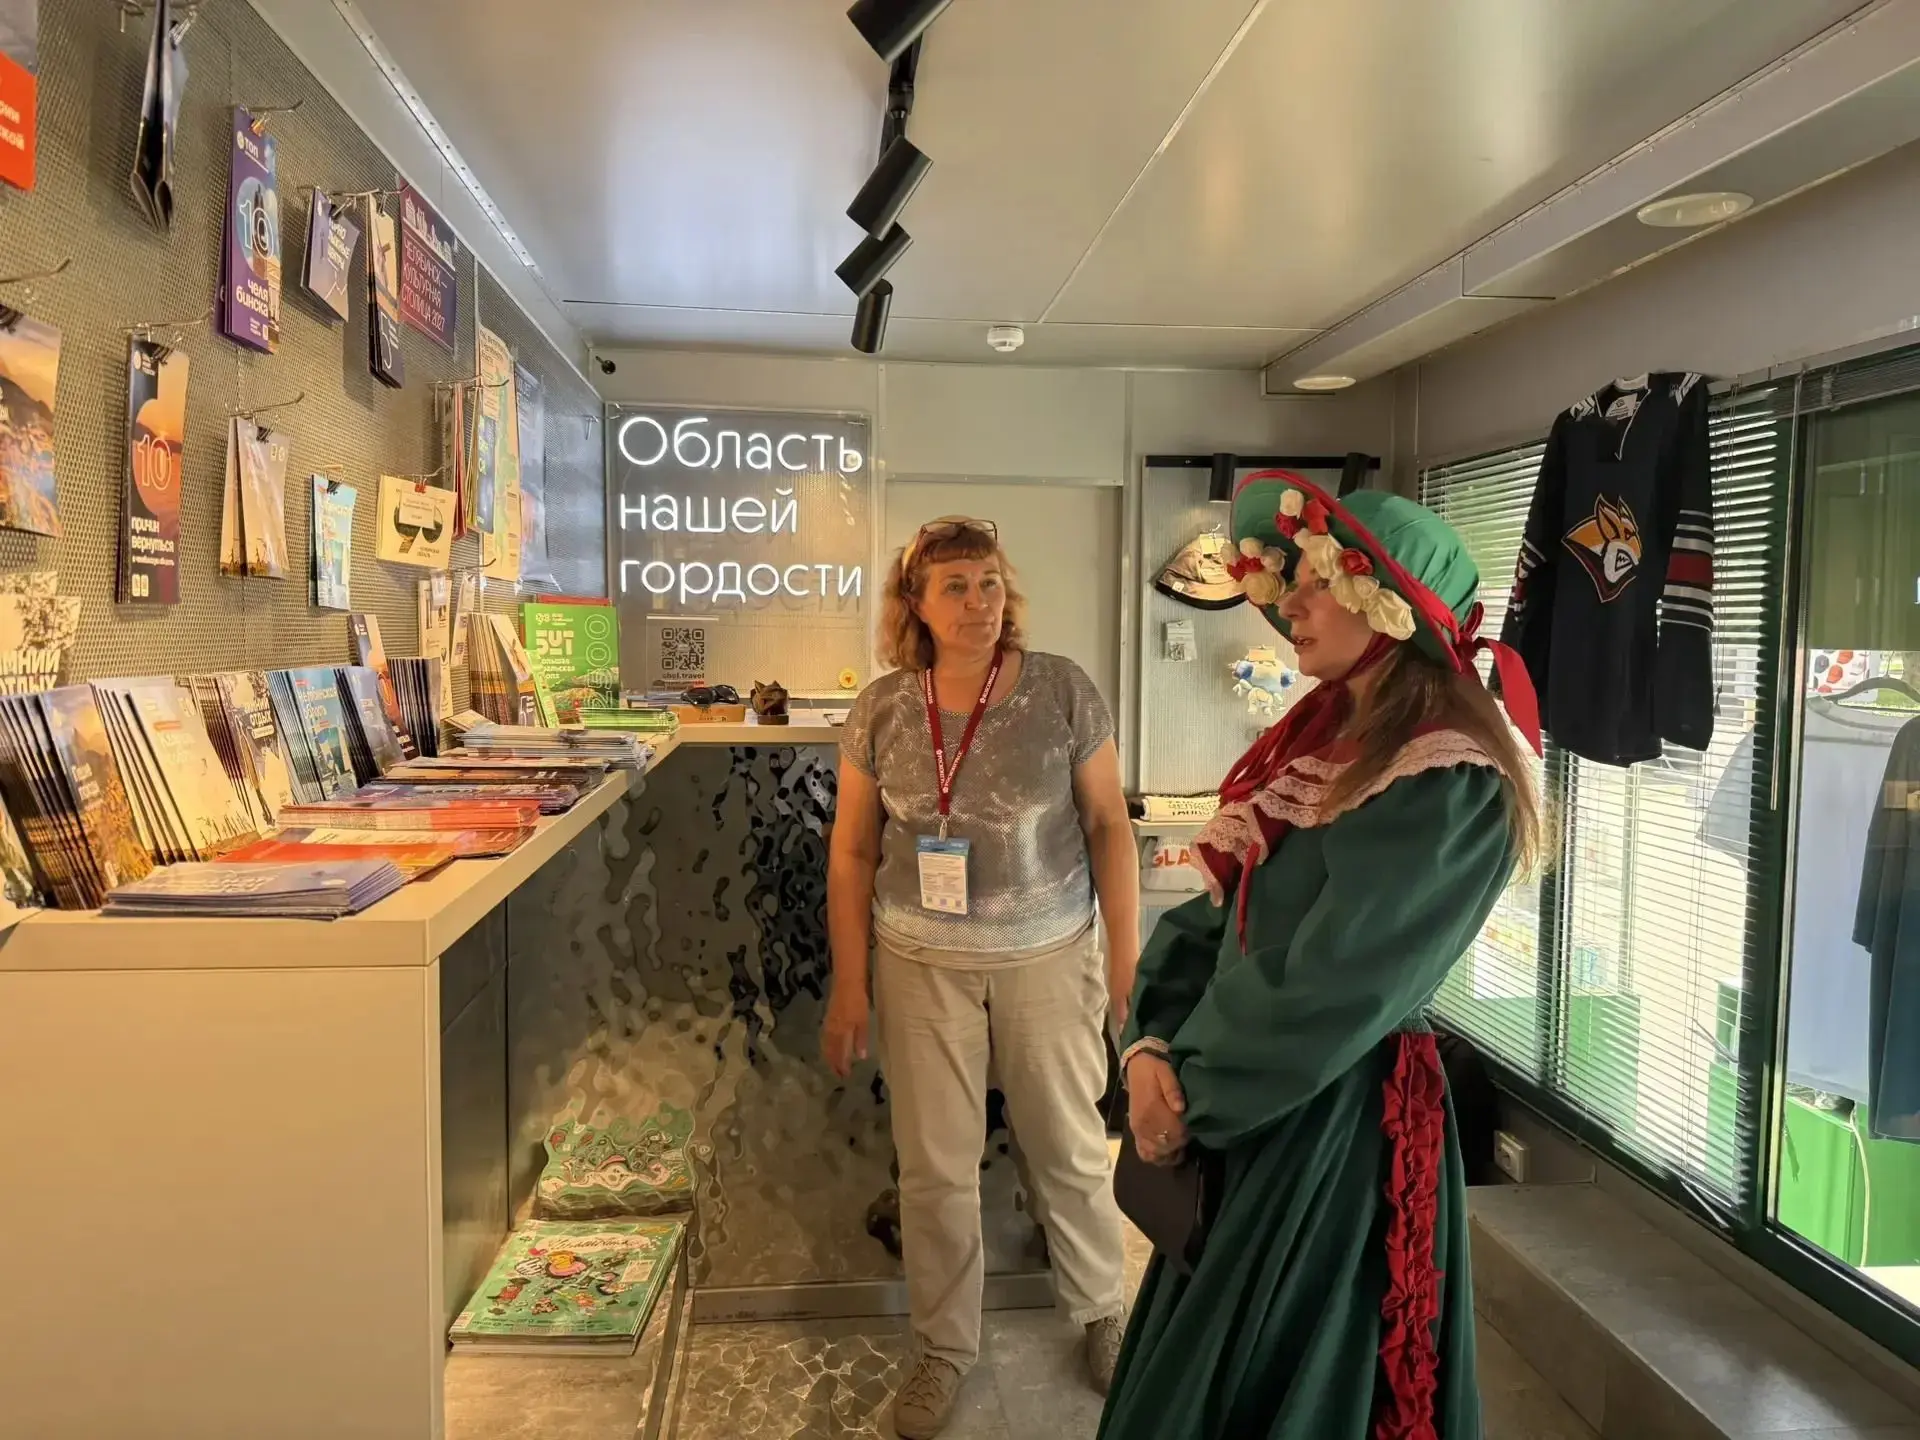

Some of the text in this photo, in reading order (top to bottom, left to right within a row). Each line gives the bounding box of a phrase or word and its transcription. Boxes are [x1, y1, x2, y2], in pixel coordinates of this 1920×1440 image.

[133, 434, 173, 491] 10
[618, 416, 863, 473] Область
[620, 488, 798, 533] нашей
[620, 560, 862, 605] гордости
